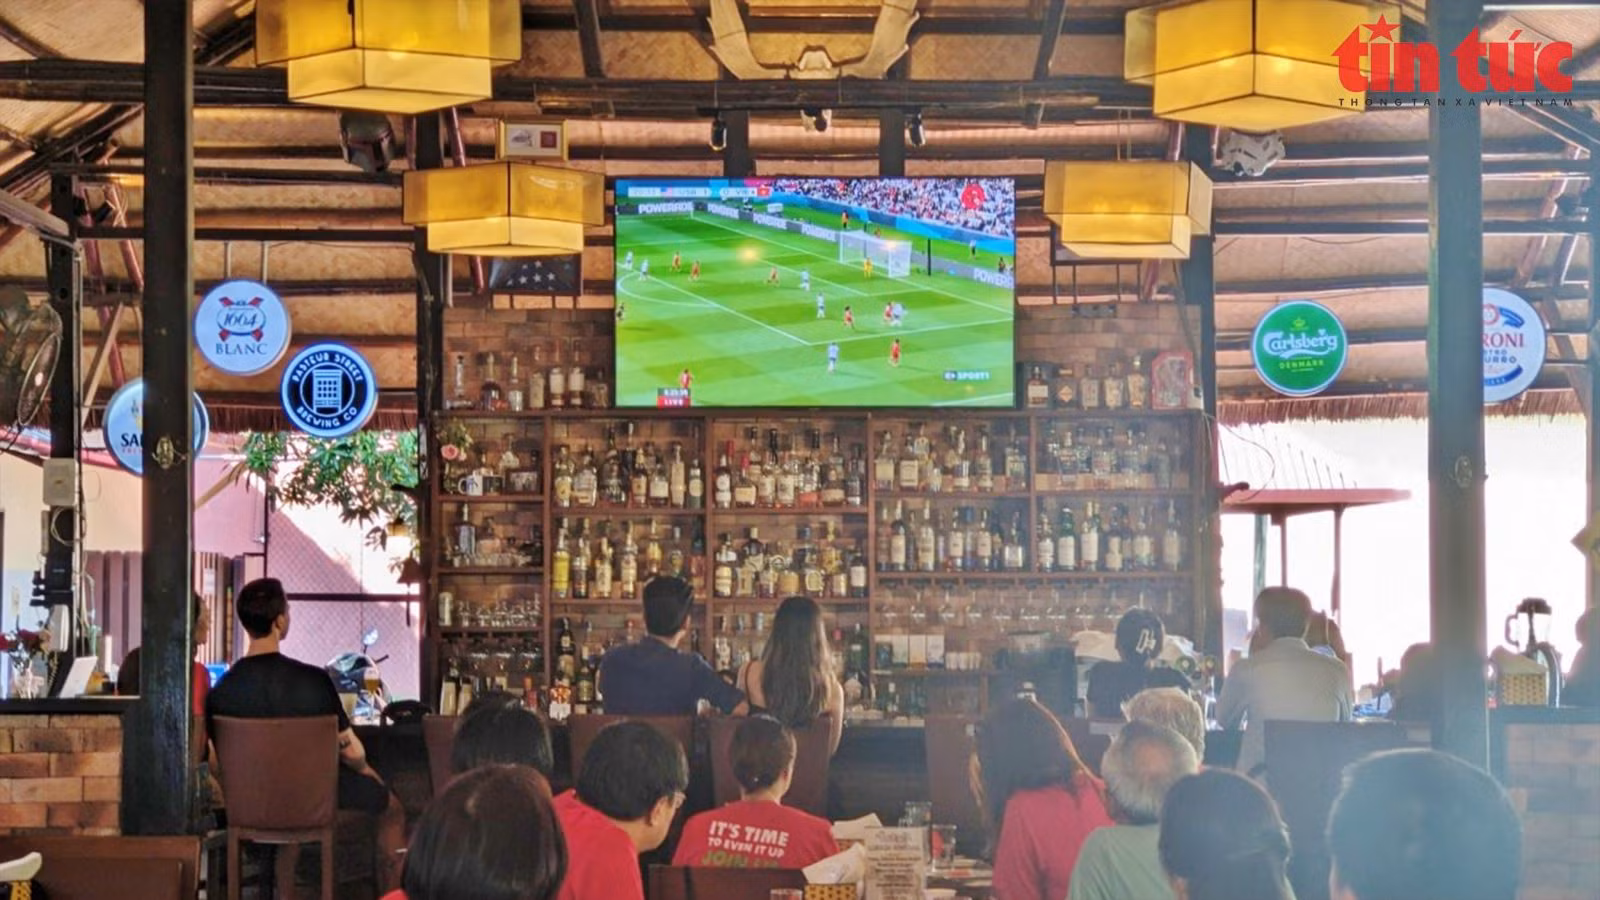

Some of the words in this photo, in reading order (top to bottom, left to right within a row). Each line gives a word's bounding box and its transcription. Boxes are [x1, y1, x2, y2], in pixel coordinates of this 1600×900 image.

[638, 202, 694, 214] POWERADE
[223, 313, 258, 327] 1664
[1263, 328, 1338, 358] Carlsberg
[1482, 332, 1525, 348] RONI
[215, 342, 269, 355] BLANC
[291, 352, 330, 383] PASTEUR
[334, 353, 364, 382] STREET
[1279, 359, 1324, 370] DENMARK
[1483, 355, 1517, 364] URRO
[296, 406, 340, 428] BREWING
[343, 406, 358, 421] CO
[709, 820, 741, 839] IT'S
[744, 826, 789, 847] TIME
[708, 837, 723, 847] TO
[724, 839, 753, 853] EVEN
[754, 844, 767, 855] IT
[768, 846, 785, 858] UP
